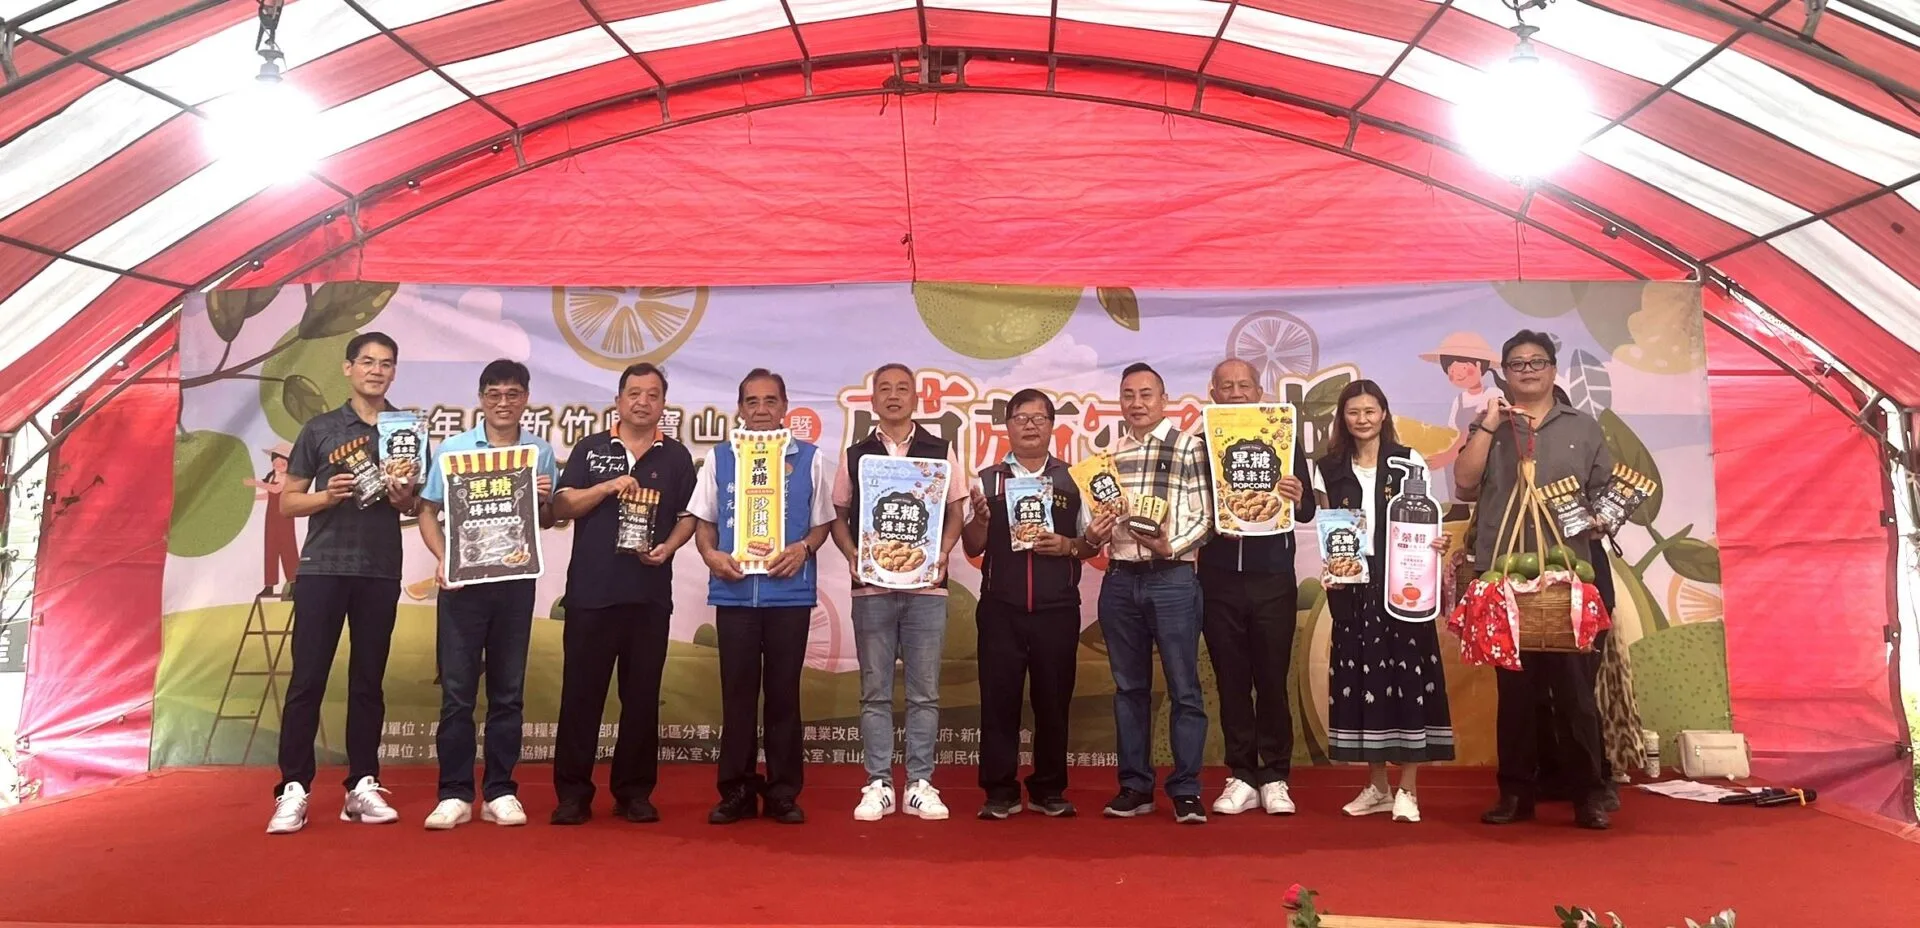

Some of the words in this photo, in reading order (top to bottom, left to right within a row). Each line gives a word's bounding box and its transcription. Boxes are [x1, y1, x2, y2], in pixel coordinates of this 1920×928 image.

[790, 415, 813, 440] 暨
[1231, 450, 1271, 469] 黑糖
[752, 457, 768, 486] 黑糖
[469, 477, 512, 499] 黑糖
[881, 503, 920, 521] 黑糖
[880, 532, 918, 541] POPCORN
